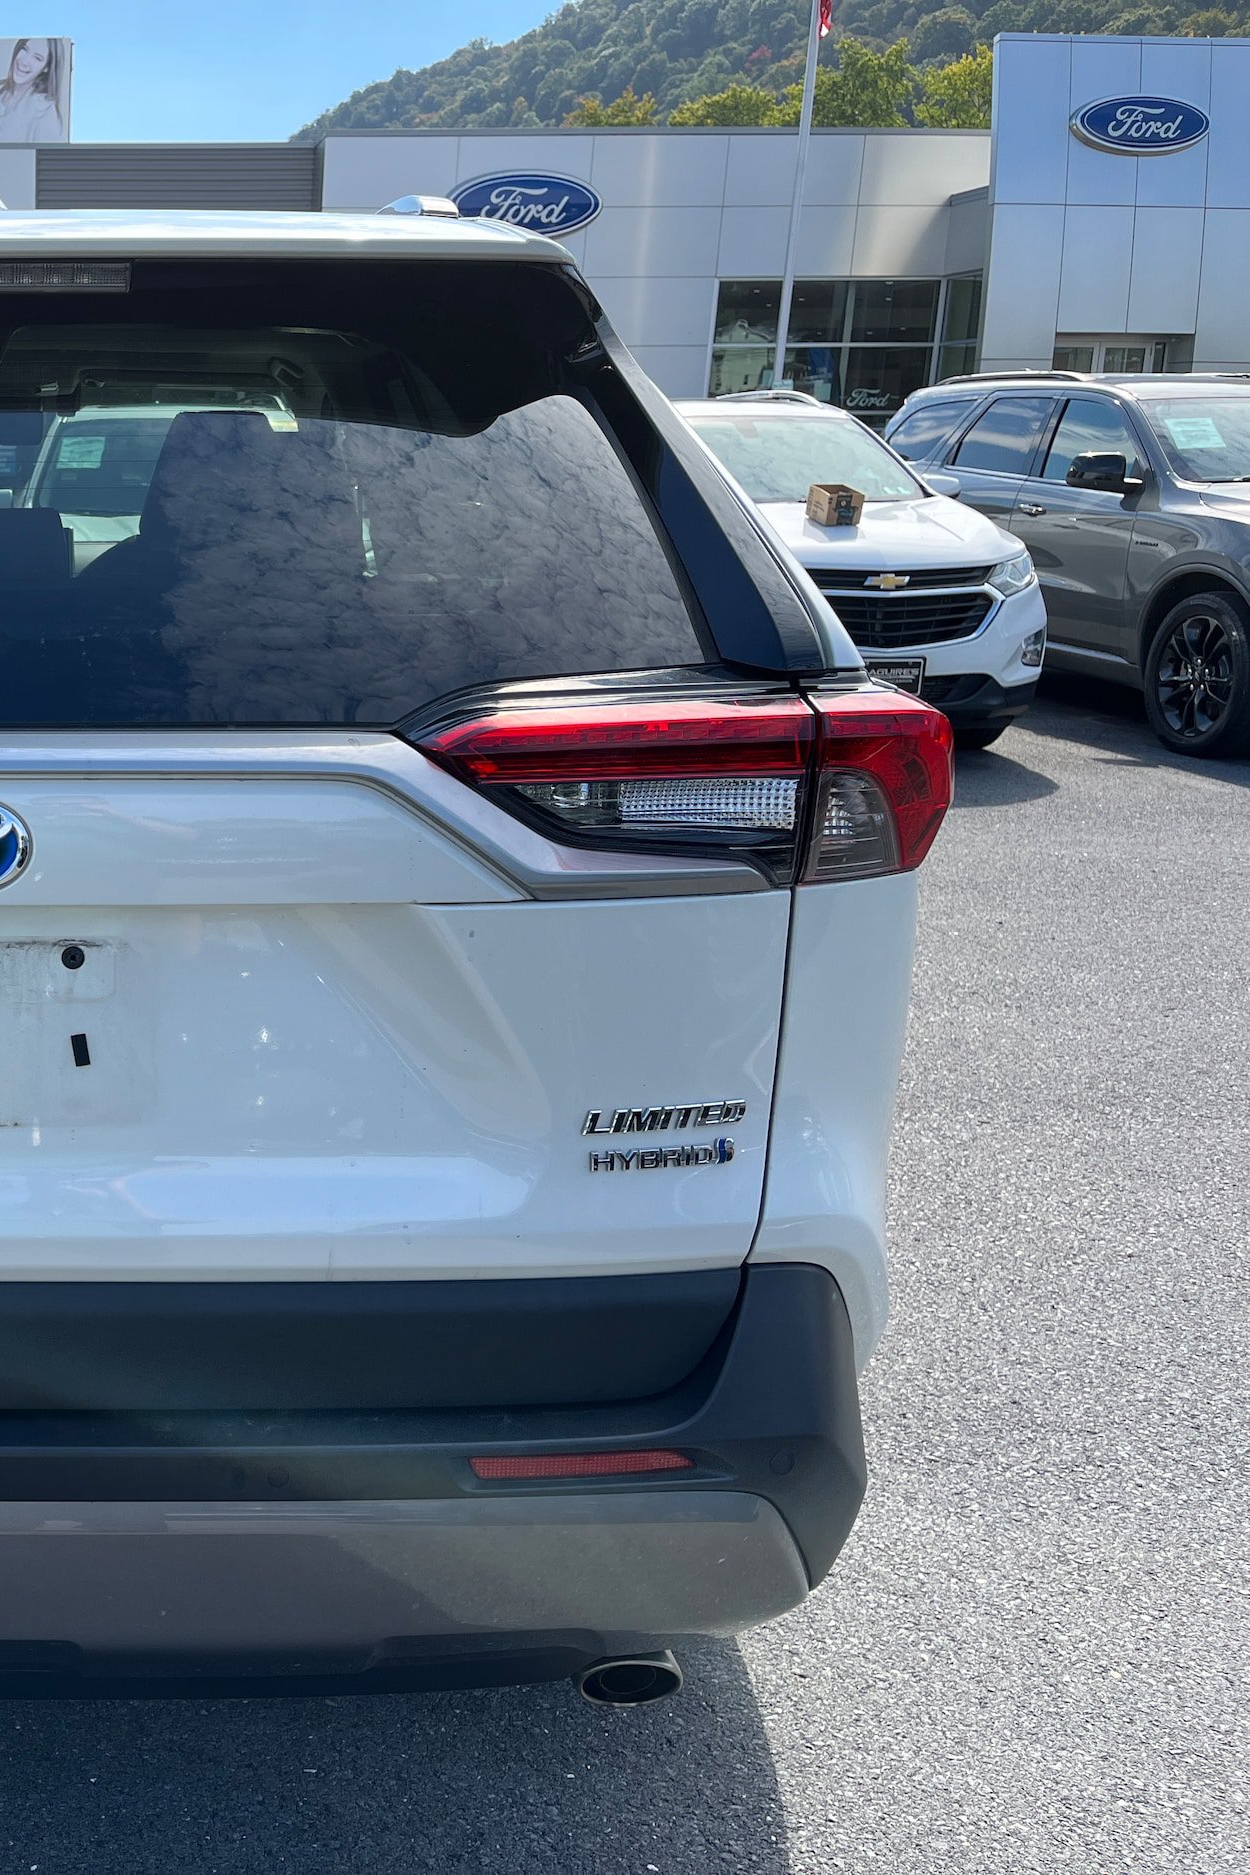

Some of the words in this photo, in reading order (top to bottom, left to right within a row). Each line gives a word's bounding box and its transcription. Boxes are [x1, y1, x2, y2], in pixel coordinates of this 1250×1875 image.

[1107, 105, 1184, 139] Ford
[480, 186, 570, 224] Ford
[846, 388, 890, 408] Ford
[581, 1099, 747, 1136] LIMITED
[590, 1144, 713, 1172] HYBRID
